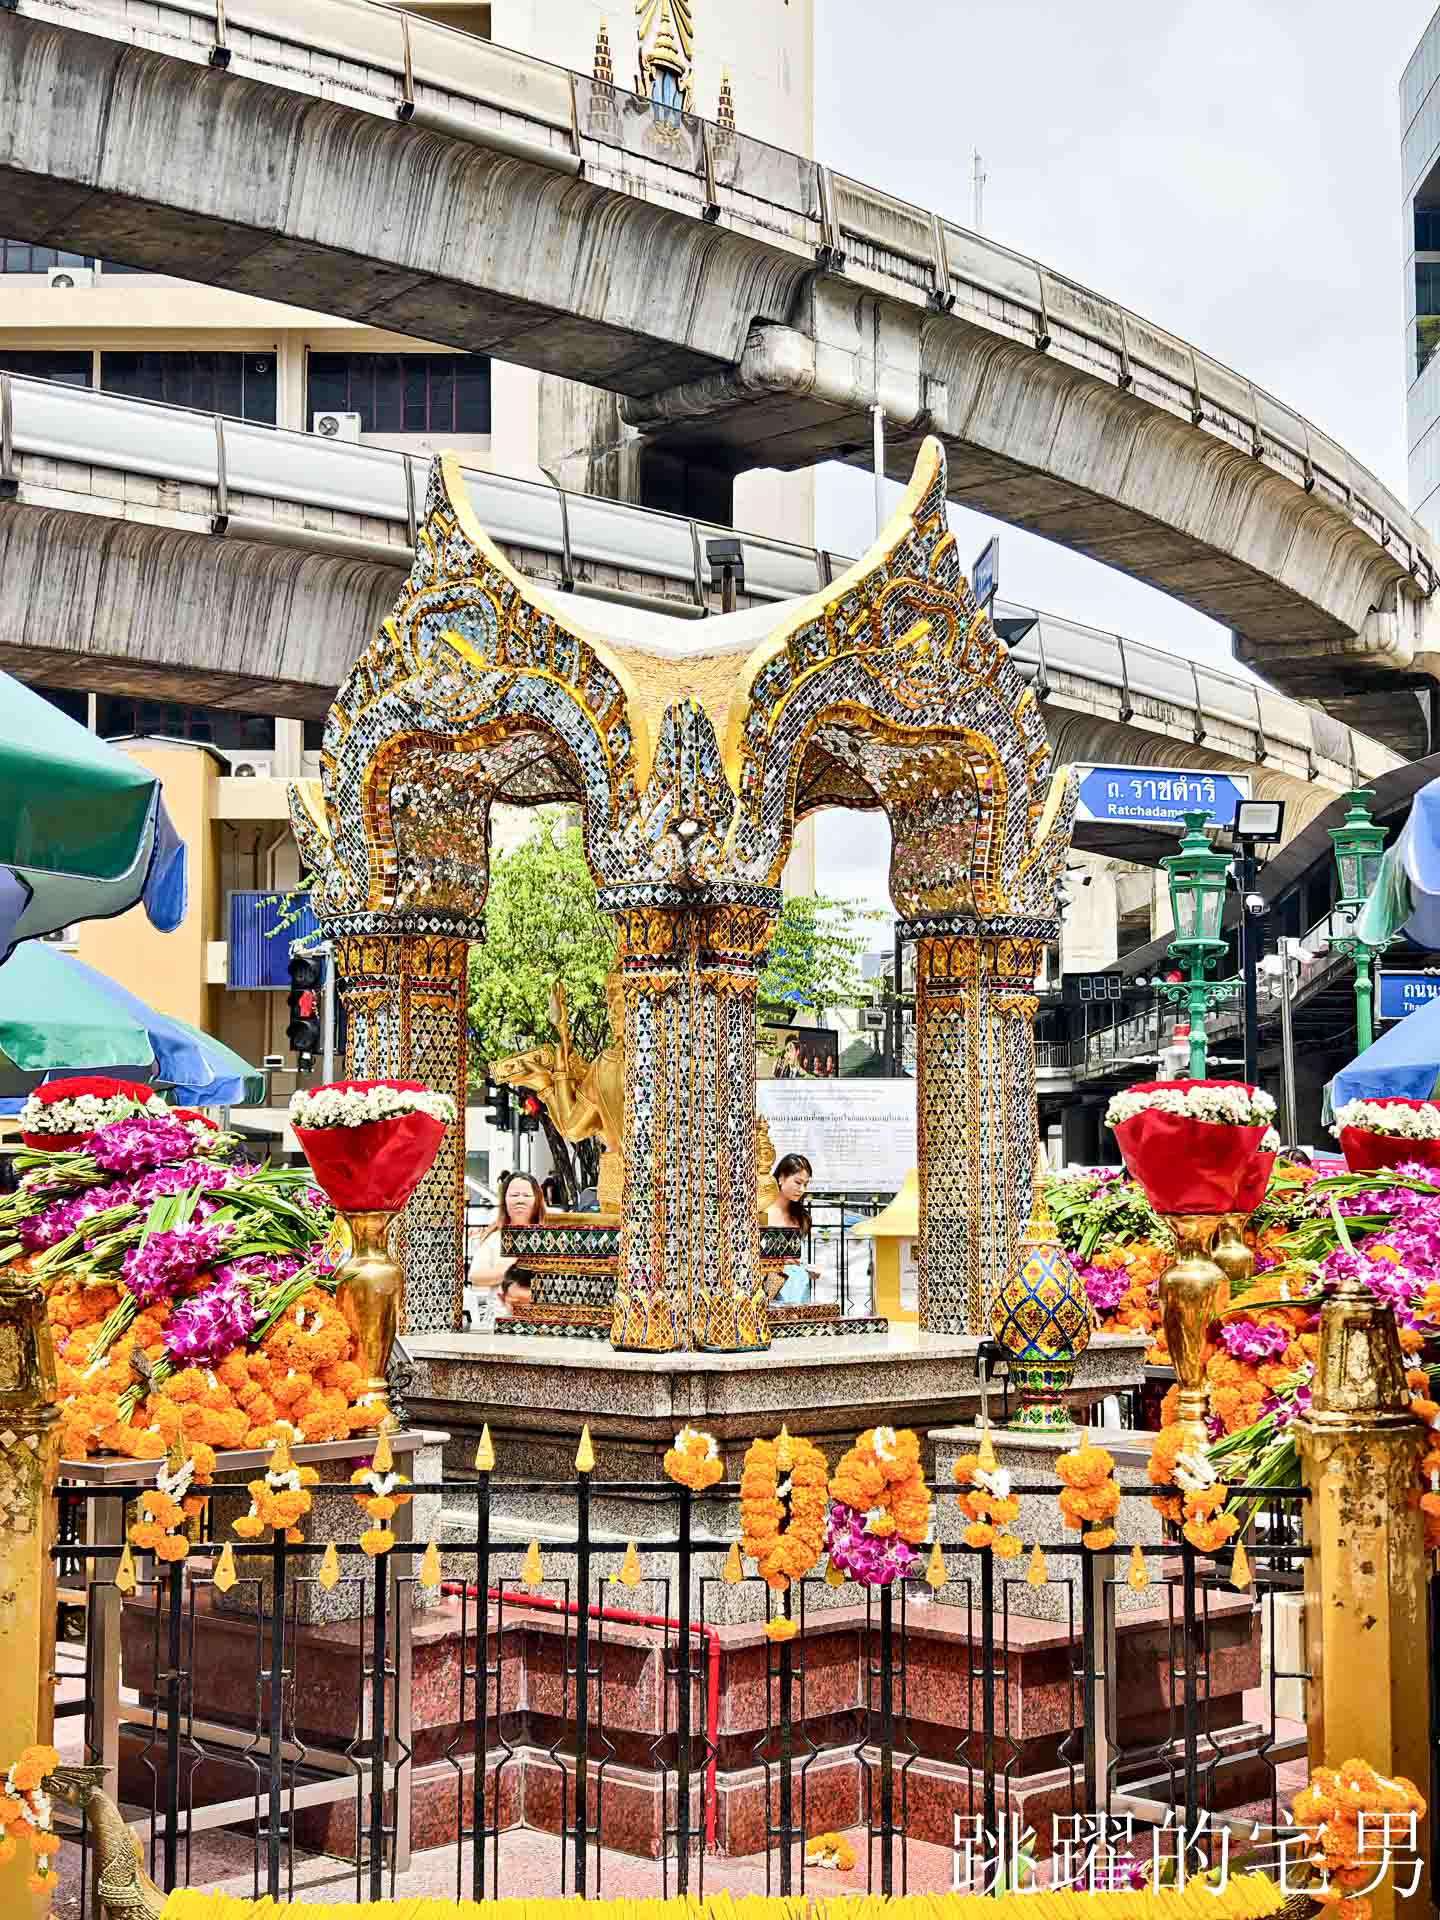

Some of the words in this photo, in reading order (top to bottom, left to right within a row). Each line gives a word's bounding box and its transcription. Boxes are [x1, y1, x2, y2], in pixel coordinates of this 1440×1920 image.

[1107, 782, 1124, 798] ถ.
[1130, 775, 1217, 803] ราชดำริ
[1404, 984, 1440, 999] ถนน
